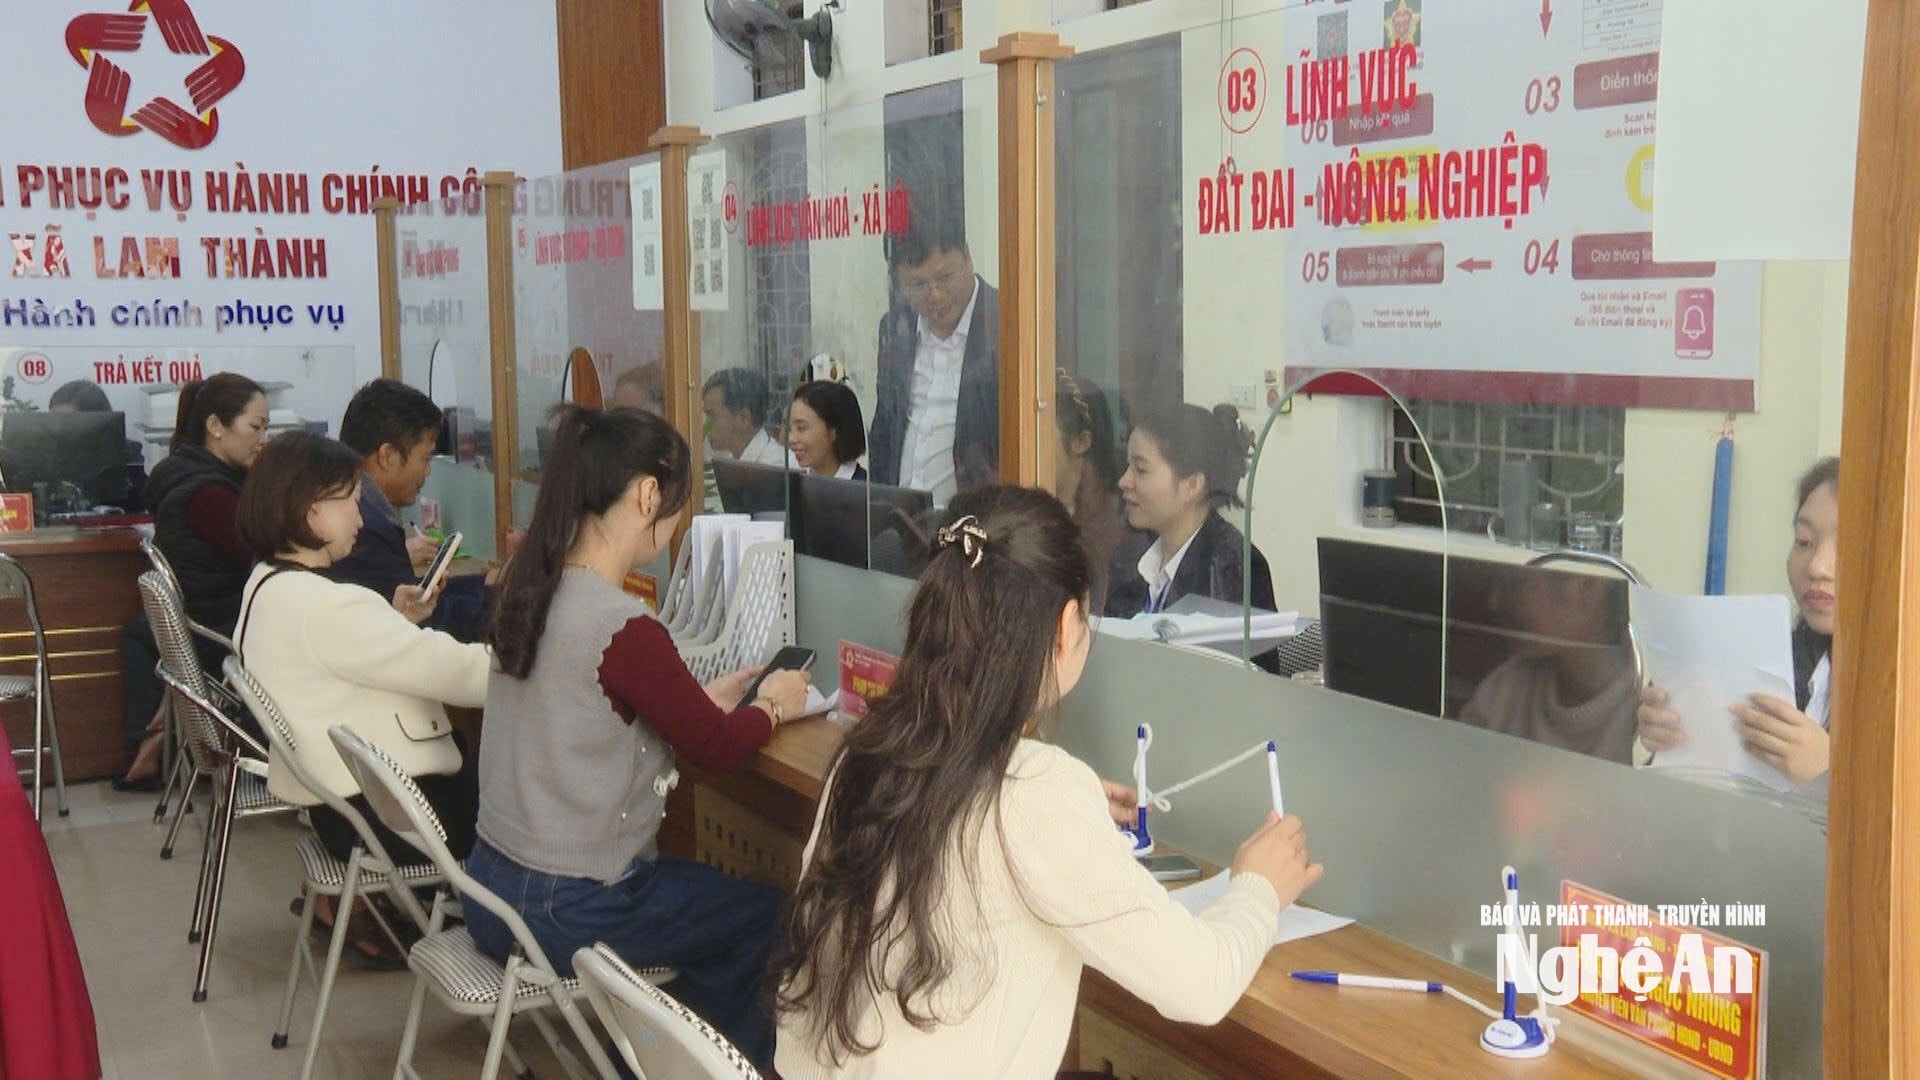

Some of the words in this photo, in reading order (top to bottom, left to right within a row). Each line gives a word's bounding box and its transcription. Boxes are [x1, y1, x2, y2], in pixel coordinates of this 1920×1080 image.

[1228, 67, 1256, 114] 03
[1286, 49, 1348, 126] LĨNH
[1359, 39, 1417, 129] VỰC
[1525, 75, 1562, 116] 03
[16, 164, 130, 221] PHỤC
[140, 168, 193, 222] VỤ
[205, 161, 310, 214] HÀNH
[322, 165, 430, 215] CHÍNH
[440, 167, 528, 216] CÔG
[1199, 156, 1243, 234] ĐẤT
[1251, 167, 1294, 231] ĐAI
[1323, 146, 1407, 227] NÔNG
[1418, 131, 1543, 229] NGHIỆP
[725, 194, 737, 221] 04
[747, 202, 771, 246] LĨNH
[774, 198, 794, 252] VỰC
[799, 192, 822, 240] VĂN
[825, 186, 850, 239] HOÁ
[863, 182, 882, 235] XÃ
[885, 176, 910, 245] HỘI
[9, 224, 71, 278] XÃ
[93, 235, 182, 279] LAM
[200, 227, 328, 279] THÀNH
[1302, 252, 1330, 283] 05
[1524, 239, 1560, 275] 04
[3, 299, 96, 327] Hành
[111, 299, 202, 327] chính
[216, 299, 294, 333] phục
[308, 304, 345, 331] vụ
[24, 360, 46, 377] 08
[94, 354, 128, 385] TRẢ
[132, 356, 163, 384] KẾT
[169, 354, 204, 385] QUẢ
